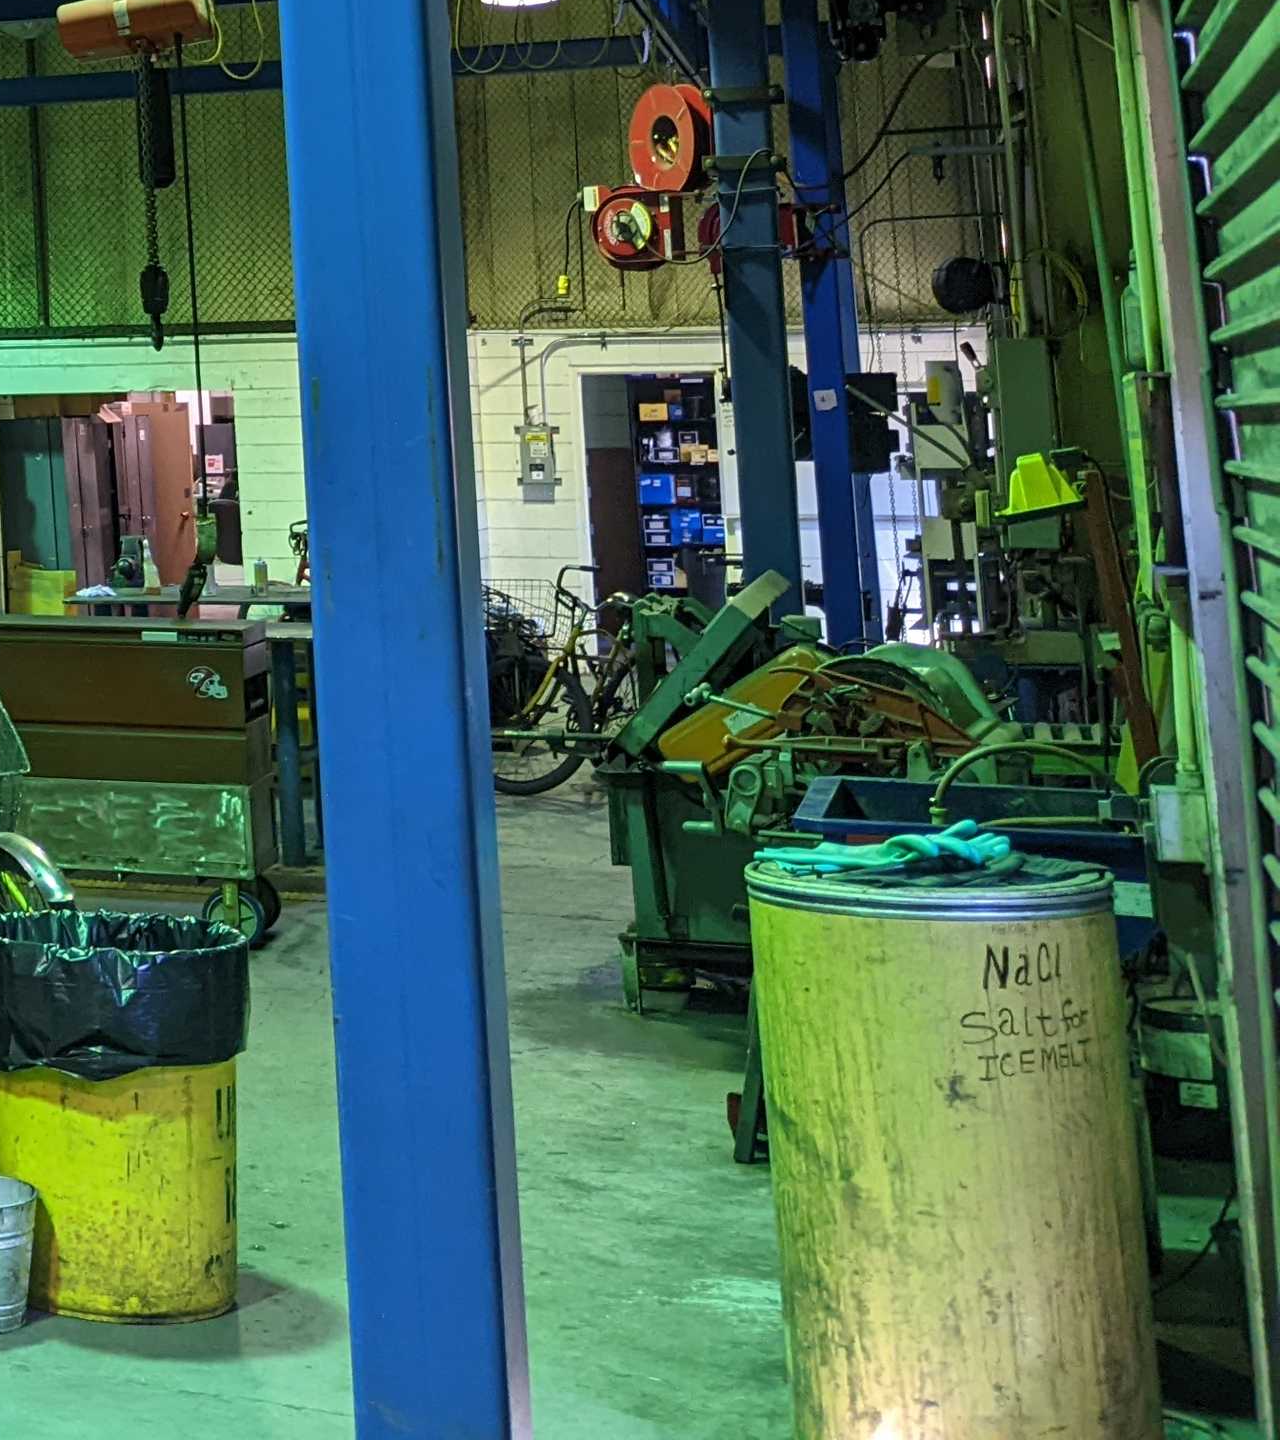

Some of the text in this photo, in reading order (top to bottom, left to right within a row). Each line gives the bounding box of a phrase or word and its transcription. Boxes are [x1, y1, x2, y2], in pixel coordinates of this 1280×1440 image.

[983, 942, 1061, 990] NaCl
[960, 997, 1089, 1045] Salt for
